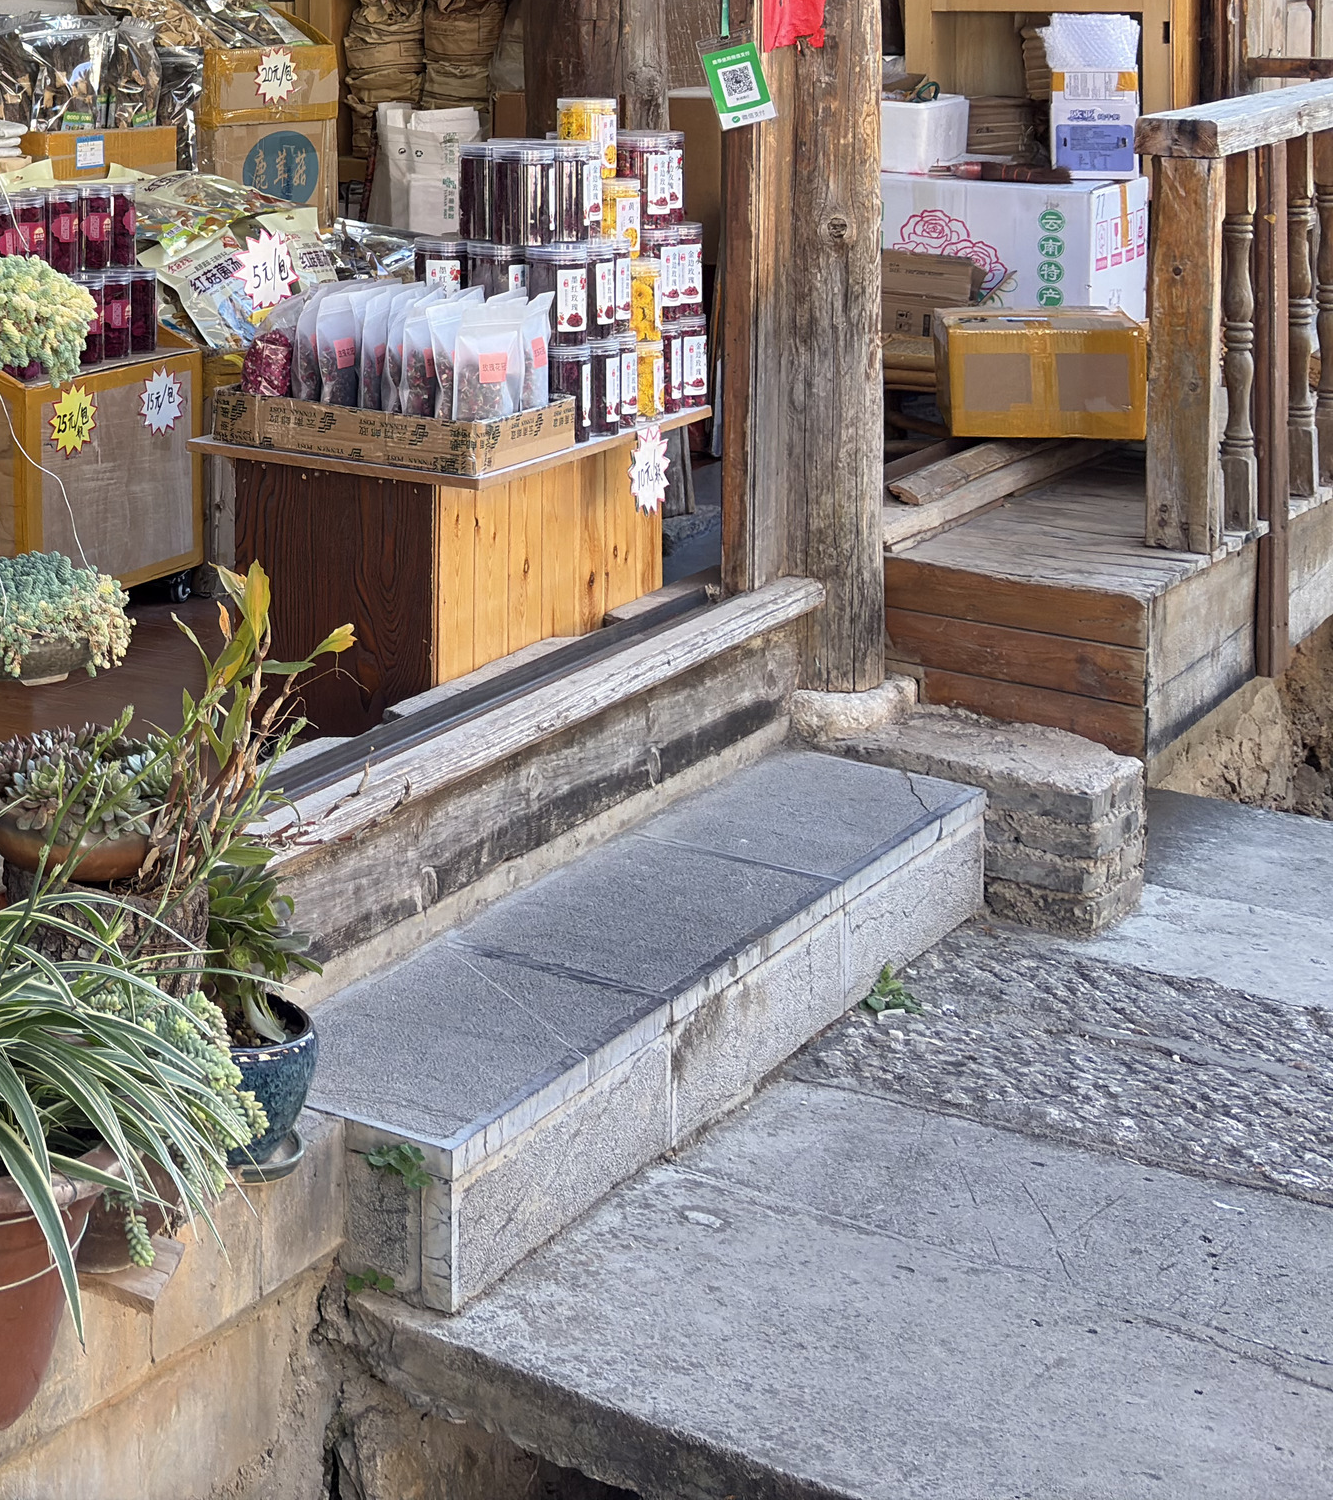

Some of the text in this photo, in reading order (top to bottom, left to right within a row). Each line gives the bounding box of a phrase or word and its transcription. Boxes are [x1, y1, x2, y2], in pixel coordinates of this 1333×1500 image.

[261, 61, 293, 88] 20元/包
[189, 257, 243, 296] 红菇菌汤
[252, 247, 289, 291] 5元/包
[1039, 211, 1065, 306] 云南特产
[570, 275, 578, 312] 墨红玫瑰
[146, 383, 176, 416] 15元/包
